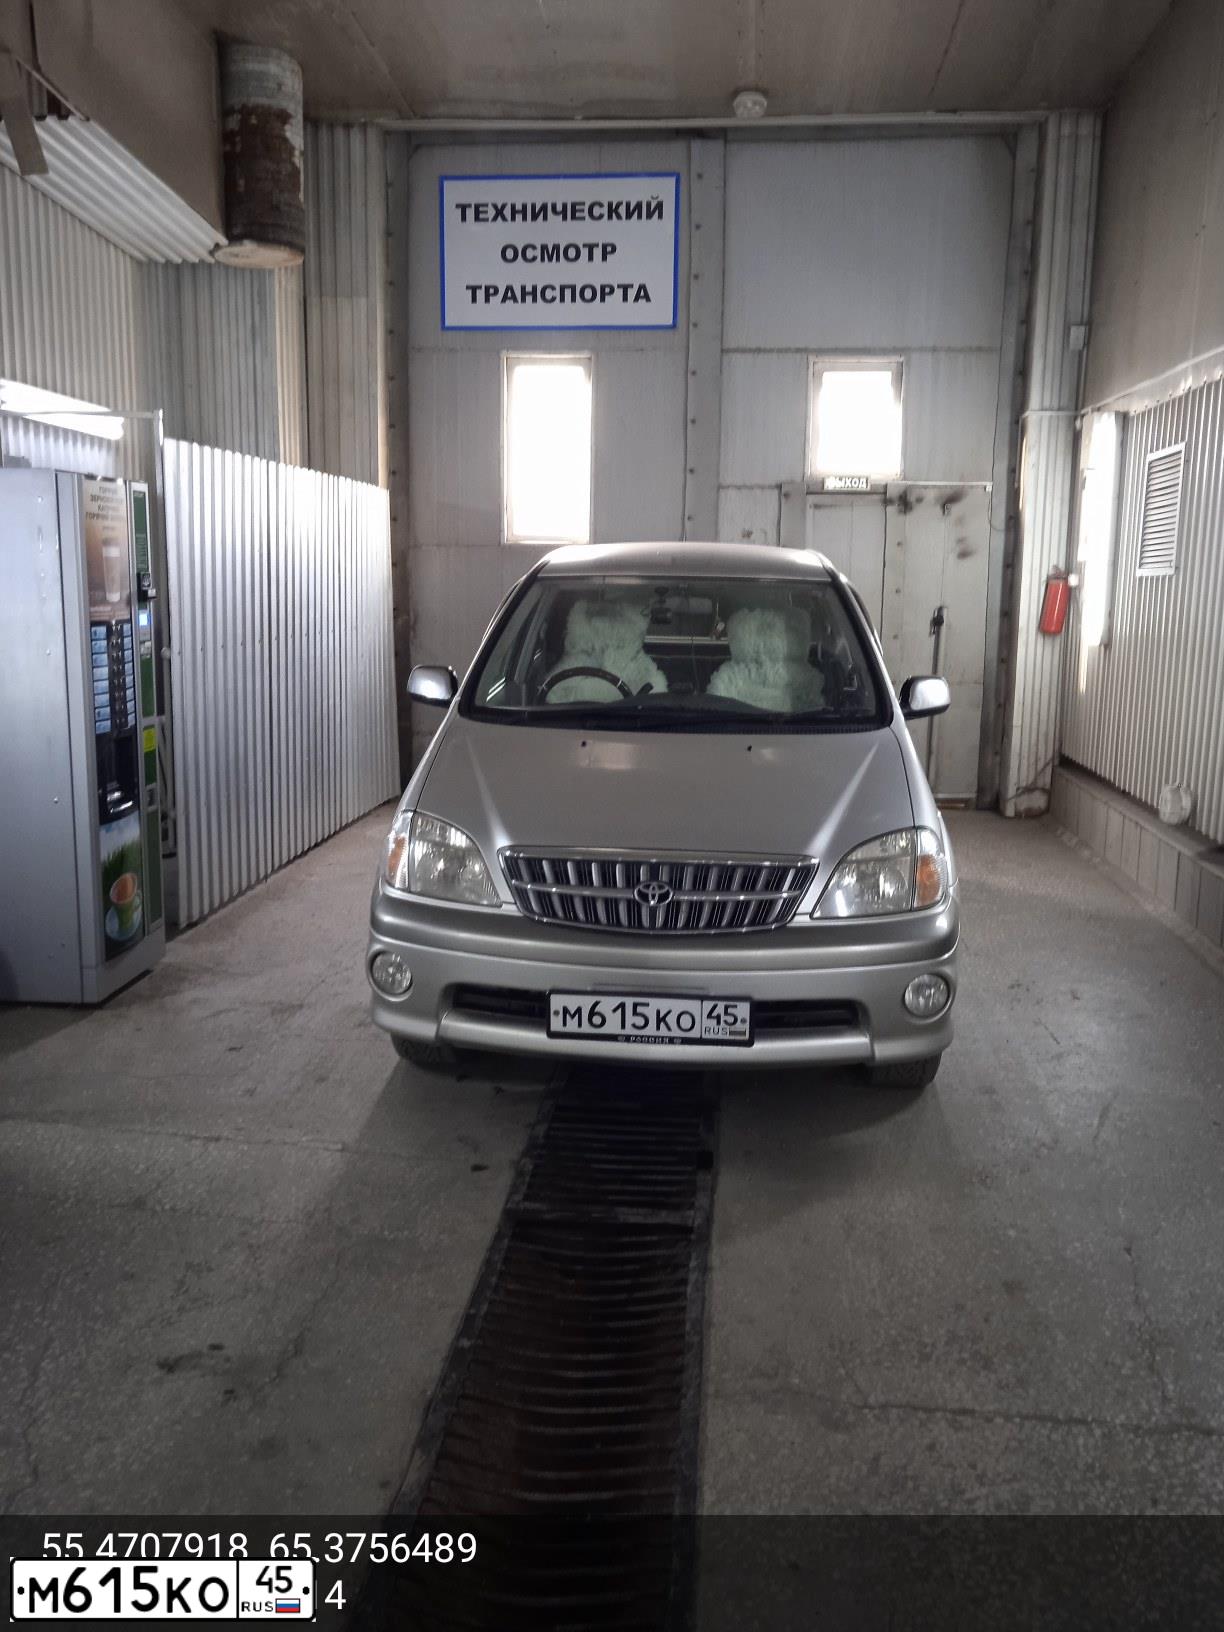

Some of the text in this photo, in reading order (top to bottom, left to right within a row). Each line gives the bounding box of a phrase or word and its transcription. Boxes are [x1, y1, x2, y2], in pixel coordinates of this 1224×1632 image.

[455, 195, 664, 222] ТЕХНИЧЕСКИЙ
[500, 242, 617, 263] ОСМОТР
[465, 284, 652, 304] ТРАНСПОРТА
[562, 1000, 739, 1032] М615КО 45
[704, 1026, 728, 1037] RUS
